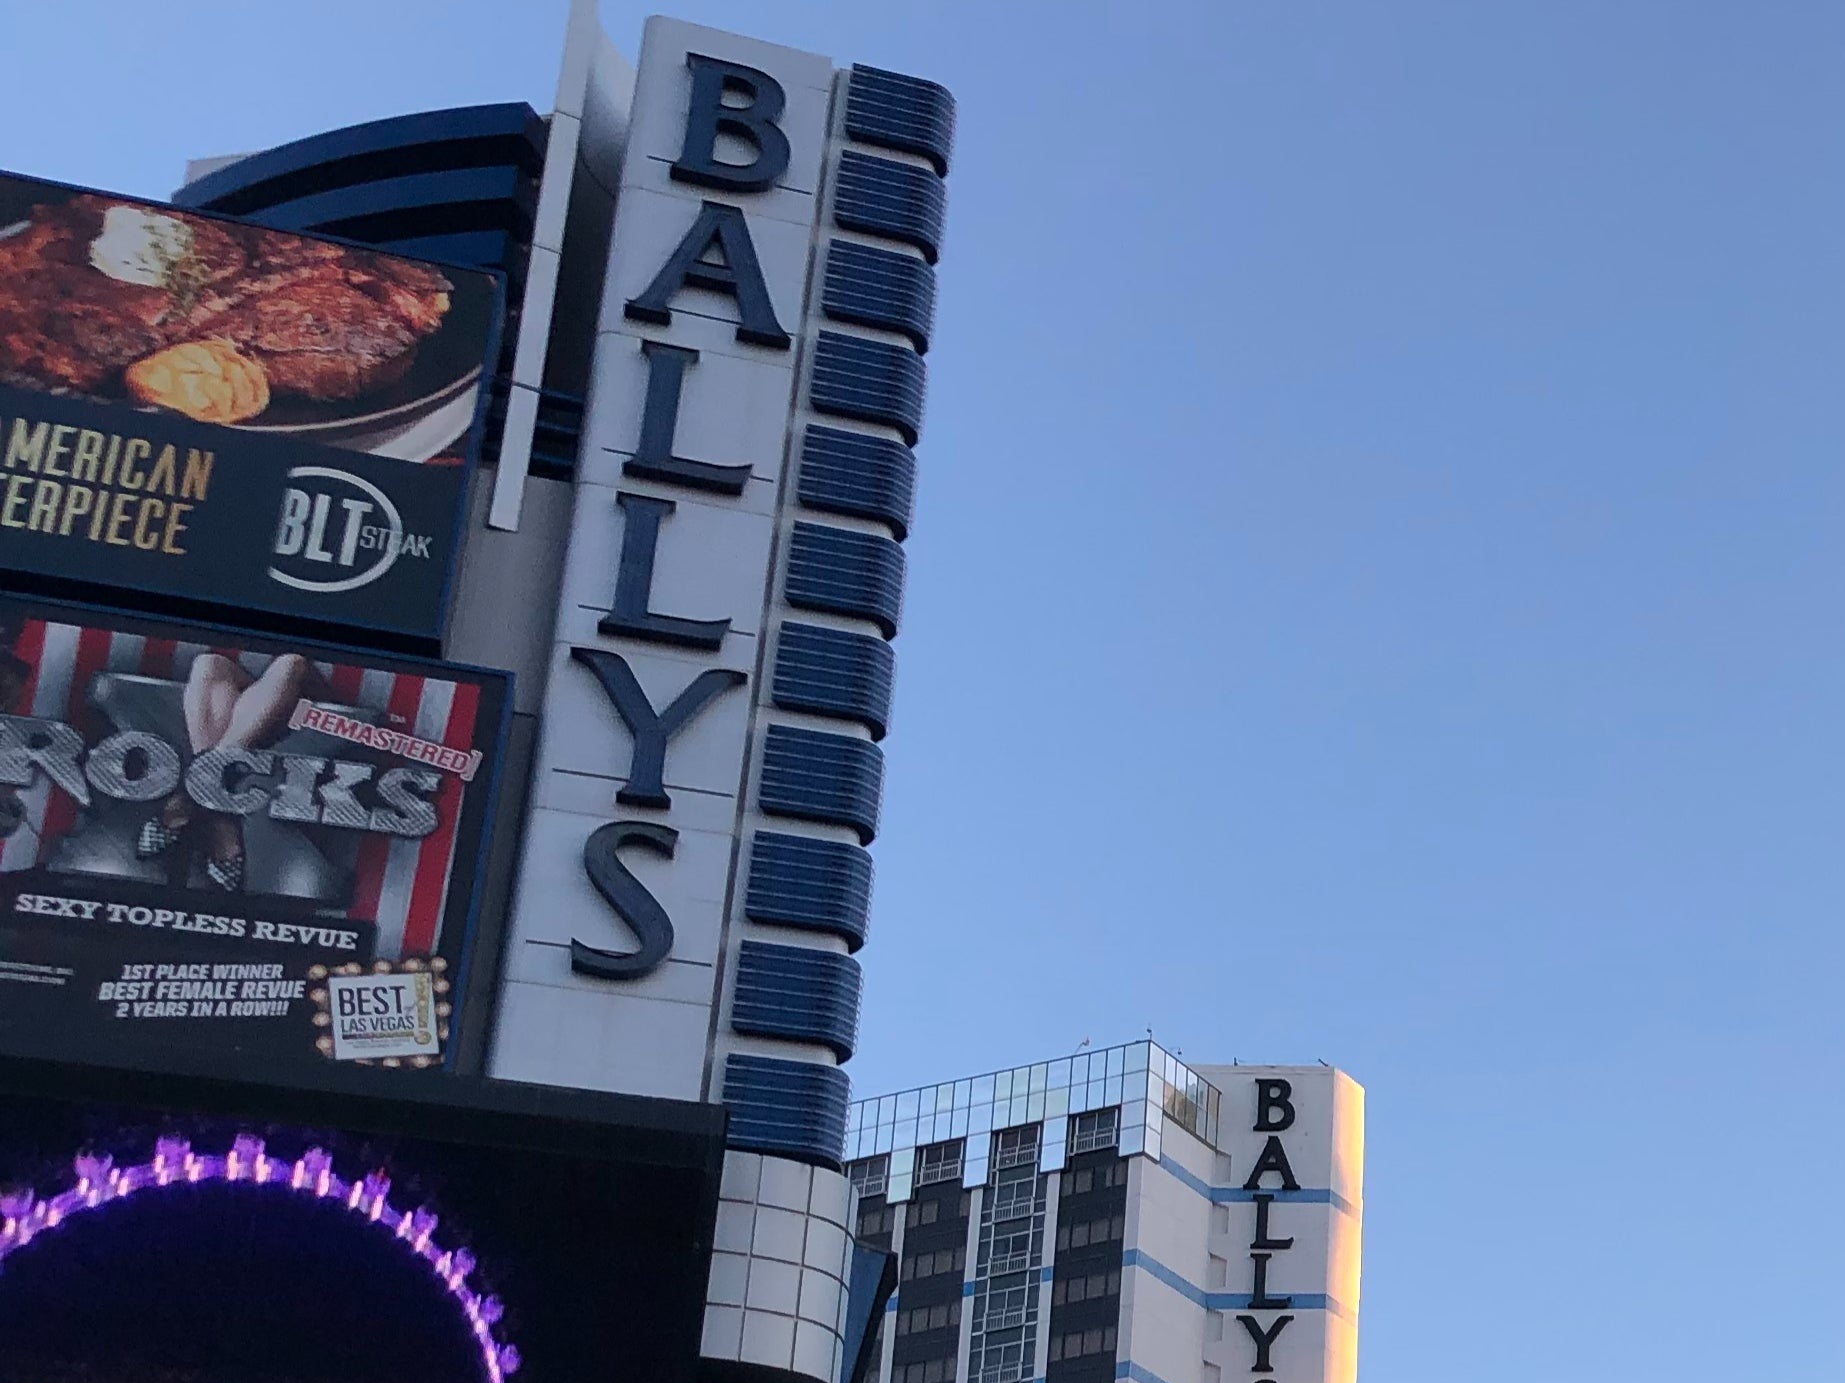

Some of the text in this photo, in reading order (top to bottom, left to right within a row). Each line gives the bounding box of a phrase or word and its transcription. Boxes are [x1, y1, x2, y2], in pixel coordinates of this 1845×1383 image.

[0, 473, 194, 555] ERPIECE
[274, 488, 432, 566] BLT STEAK
[571, 52, 792, 981] BALLYS
[0, 714, 443, 838] ROCKS
[15, 893, 359, 951] SEXY TOPLESS REVUE
[98, 980, 306, 1000] BEST FEMALE REVUE
[121, 964, 284, 980] 1ST PLACE WINNER
[115, 1001, 290, 1018] 2 YEARS IN A ROW!!!
[338, 985, 406, 1016] BEST
[341, 1015, 415, 1033] LAS VEGAS
